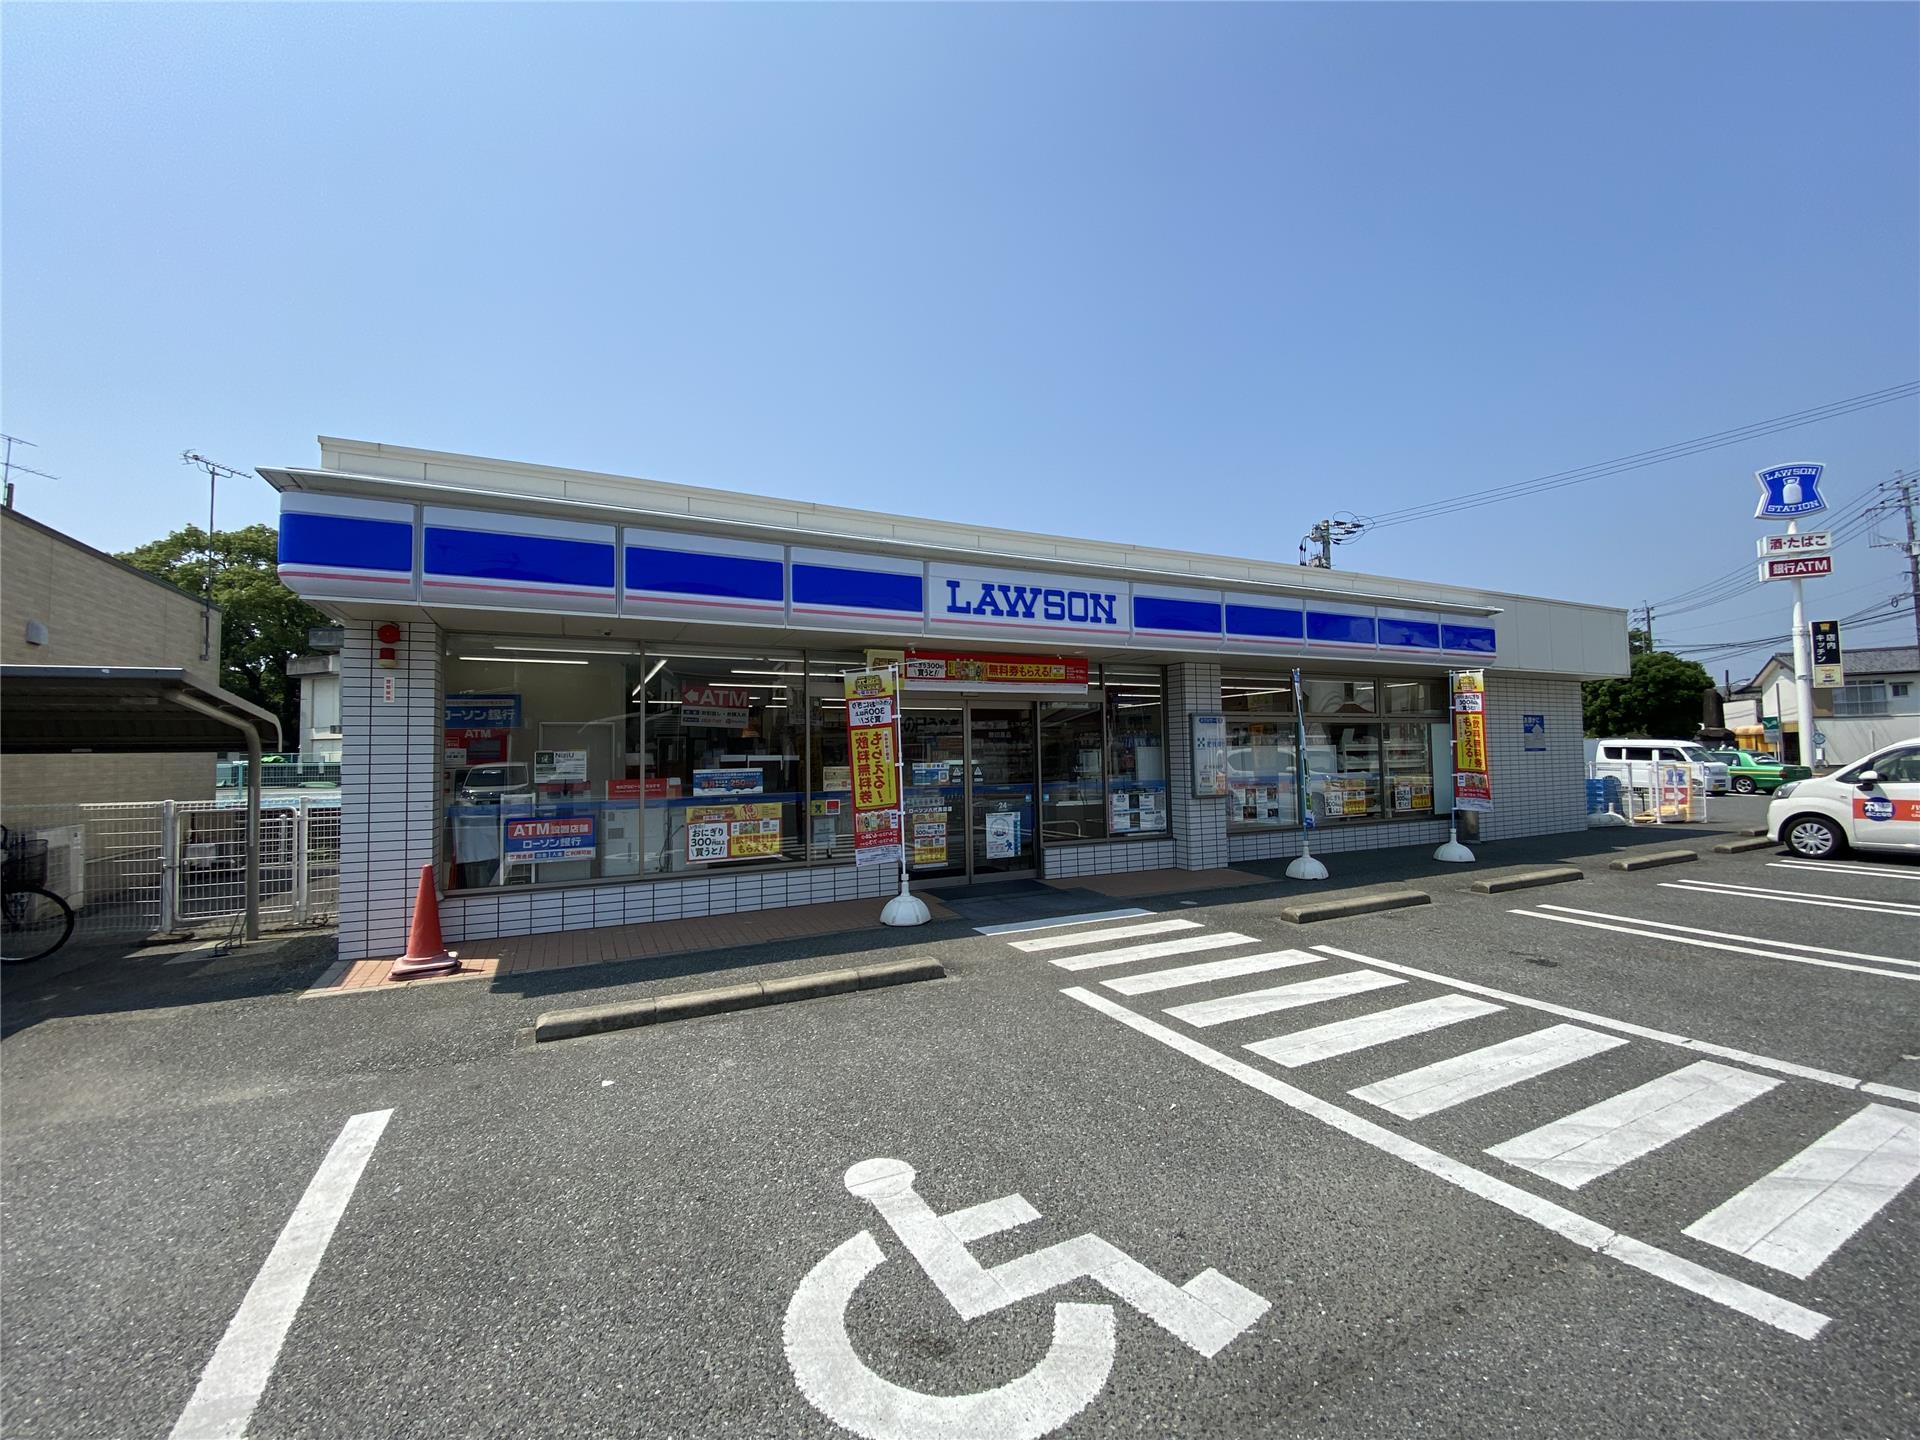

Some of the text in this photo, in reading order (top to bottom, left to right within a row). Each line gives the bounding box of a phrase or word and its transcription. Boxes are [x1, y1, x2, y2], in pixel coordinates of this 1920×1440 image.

[1765, 468, 1817, 481] LAWSON
[1768, 500, 1819, 512] STATION
[1773, 560, 1828, 574] 銀行ATM
[946, 580, 1117, 624] LAWSON
[1816, 634, 1826, 662] キッチン
[1826, 634, 1836, 649] 店内
[700, 689, 748, 707] ATM
[464, 729, 492, 738] ATM
[692, 827, 724, 837] おにぎり
[523, 837, 581, 848] ローソン銀行
